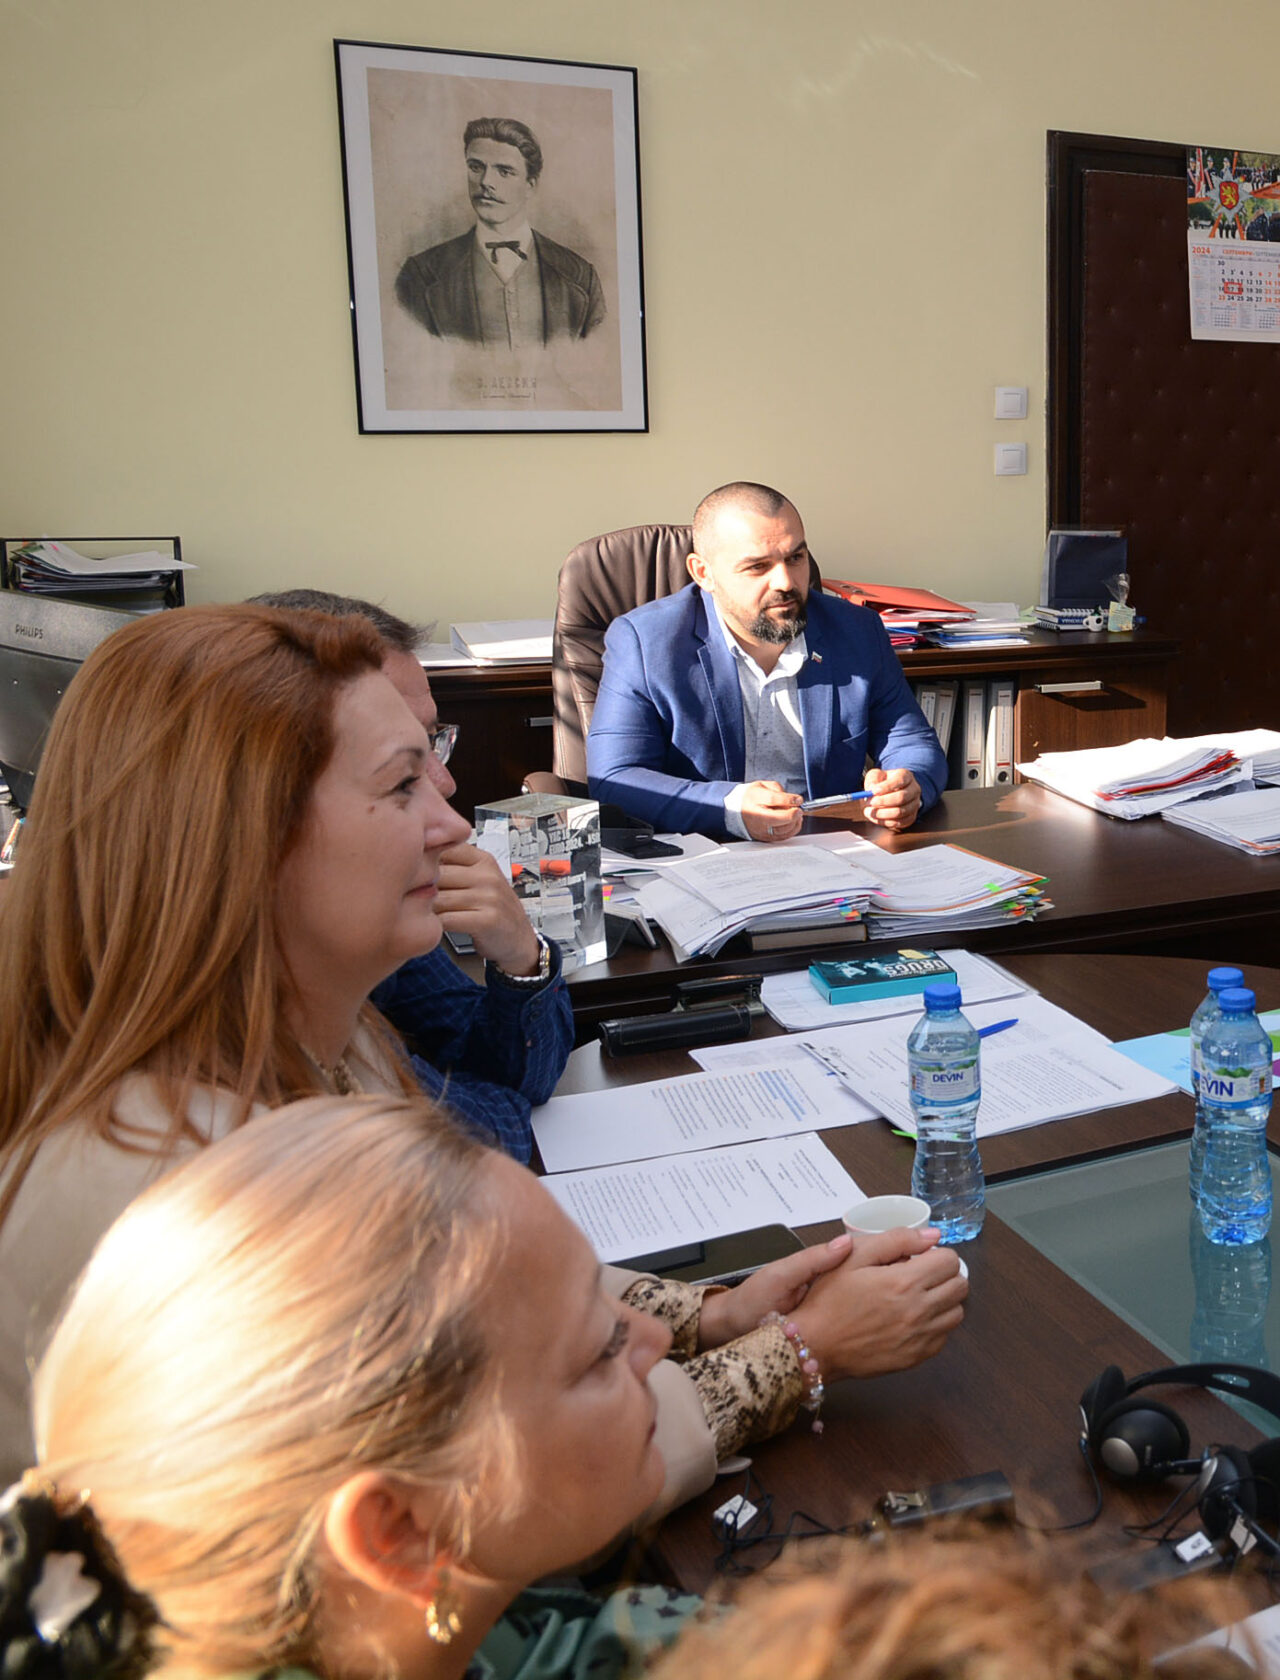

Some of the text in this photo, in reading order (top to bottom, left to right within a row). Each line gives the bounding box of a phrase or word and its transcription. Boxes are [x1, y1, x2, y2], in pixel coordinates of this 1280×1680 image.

[15, 624, 44, 640] PHILIPS
[881, 958, 948, 976] DRUGS
[932, 1071, 964, 1084] DEVIN
